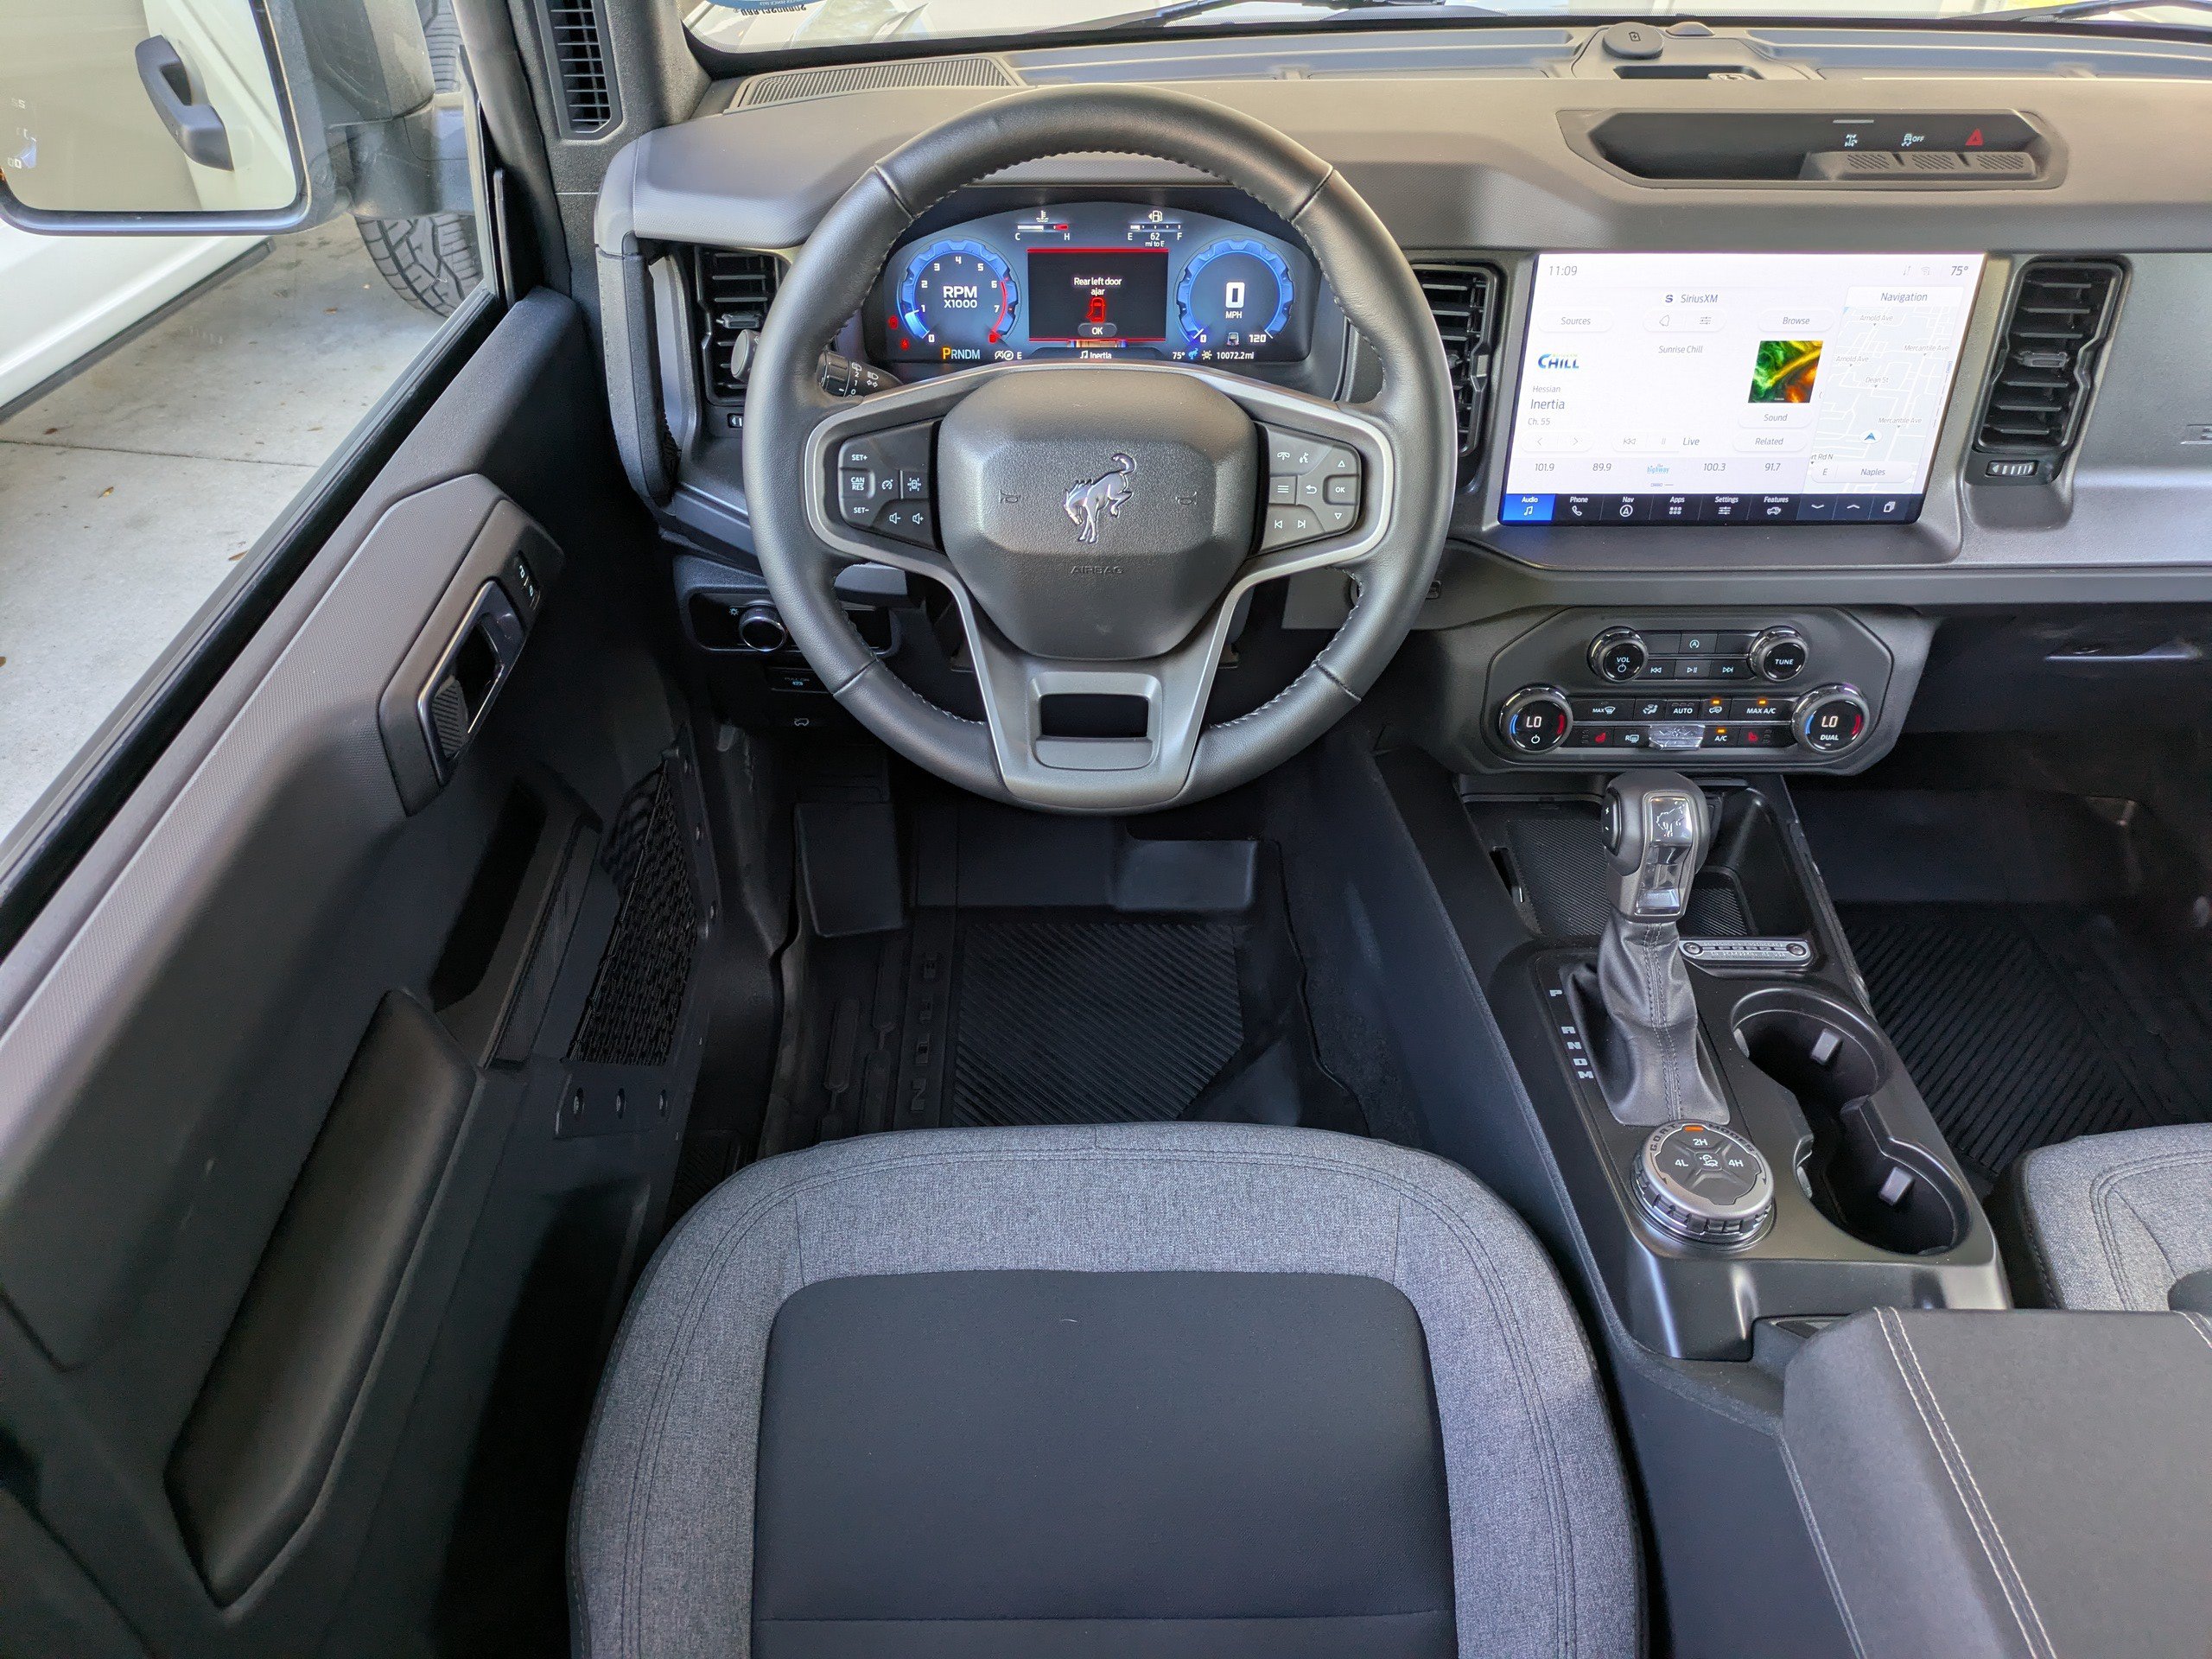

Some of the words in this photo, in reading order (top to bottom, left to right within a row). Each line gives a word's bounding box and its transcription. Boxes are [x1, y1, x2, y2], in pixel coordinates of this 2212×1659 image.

[1014, 232, 1020, 241] C
[1064, 232, 1071, 241] H
[1128, 232, 1133, 241] E
[1150, 232, 1160, 241] 62
[1177, 232, 1182, 241] F
[955, 256, 962, 264] 4
[934, 263, 940, 271] 3
[977, 263, 983, 271] 5
[1548, 265, 1578, 276] 11:09
[1950, 265, 1969, 276] 75°
[921, 280, 928, 289] 2
[991, 280, 997, 289] 6
[1073, 277, 1090, 286] Rear
[1090, 277, 1104, 286] left
[1105, 277, 1122, 286] door
[943, 286, 977, 298] RPM
[1090, 288, 1105, 296] ajar
[1225, 282, 1245, 308] 0
[1681, 294, 1718, 303] SiriusXM
[1880, 292, 1928, 303] Navigation
[944, 300, 977, 308] X1000
[1560, 316, 1592, 326] Sources
[1783, 316, 1810, 325] Browse
[1091, 327, 1103, 335] OK
[928, 334, 935, 343] 0
[1199, 334, 1207, 343] 0
[1249, 334, 1267, 343] 120
[1658, 346, 1685, 354] Sunrise
[1687, 346, 1703, 354] Chill
[1530, 399, 1565, 410] Inertia
[1528, 417, 1539, 426] Ch.
[1541, 417, 1551, 426] 55
[1682, 437, 1700, 446] Live
[1755, 437, 1783, 446] Related
[1535, 463, 1555, 472] 101.9
[1592, 463, 1611, 472] 89.9
[1703, 463, 1726, 472] 100.3
[1764, 463, 1781, 472] 91.7
[1860, 468, 1885, 478] Naples
[1070, 565, 1124, 575] AIRBAG
[1573, 1058, 1588, 1066] D
[1578, 1071, 1594, 1079] M
[1675, 1159, 1689, 1167] 4L
[1728, 1159, 1744, 1167] 4H
